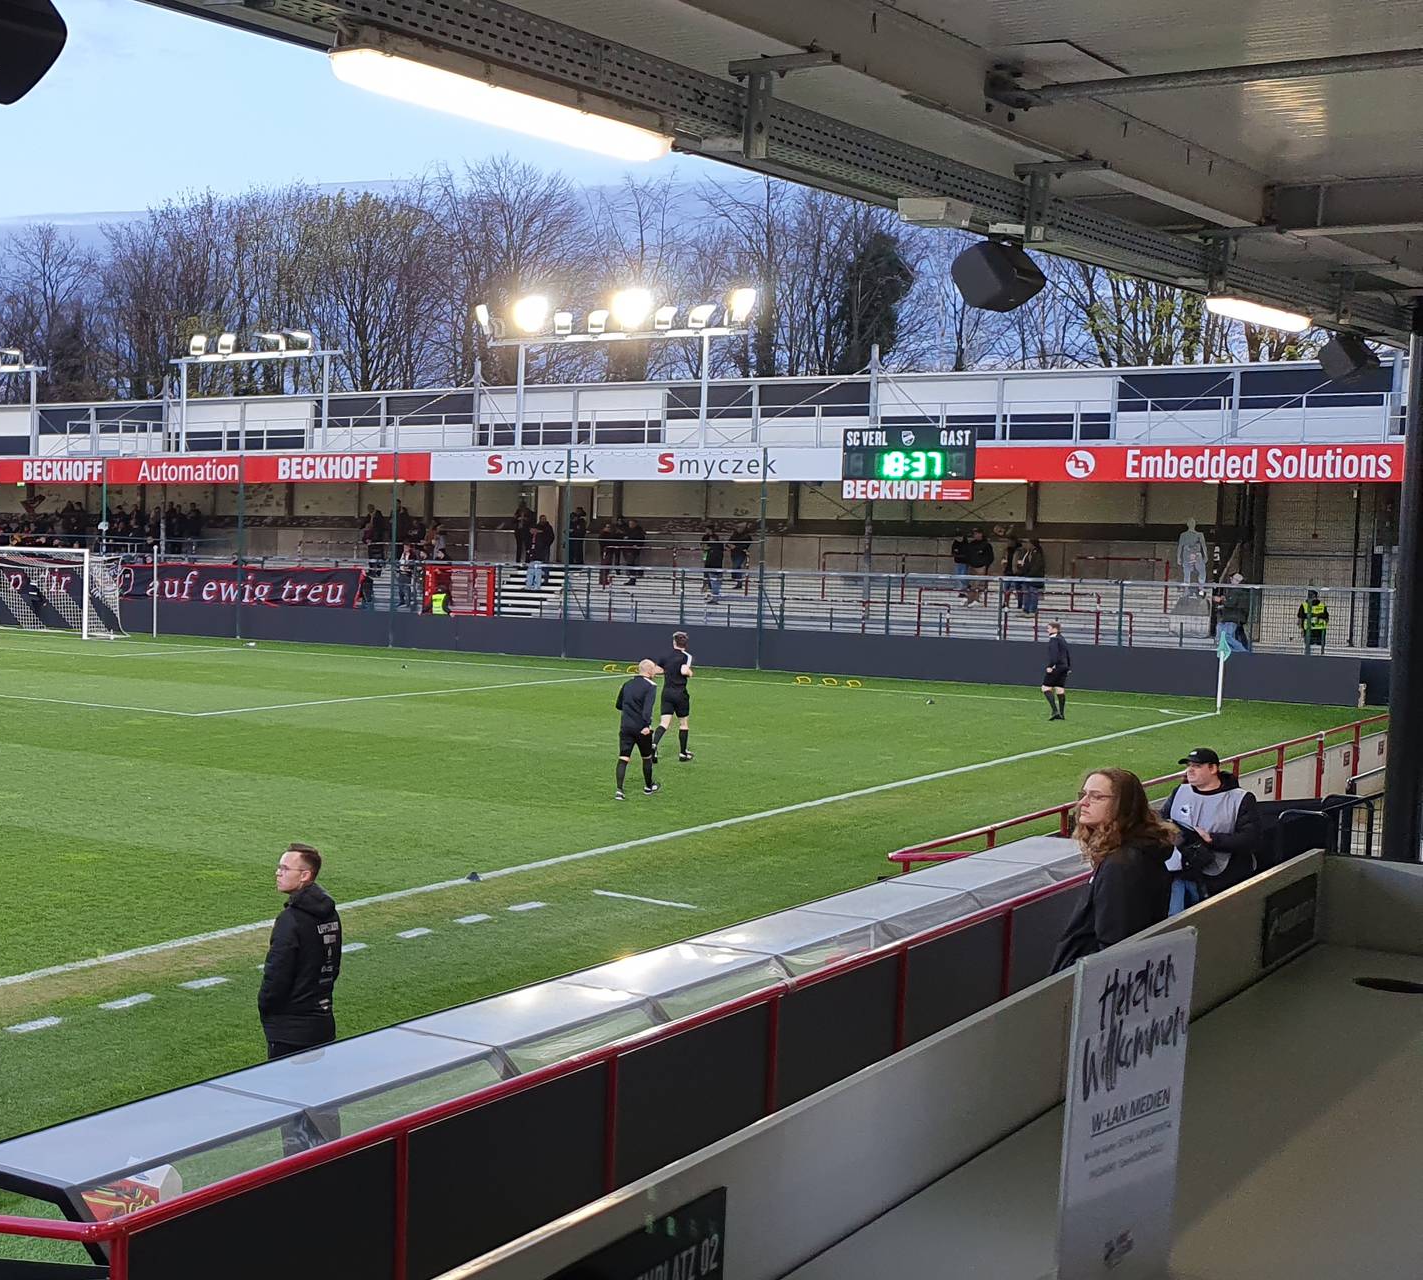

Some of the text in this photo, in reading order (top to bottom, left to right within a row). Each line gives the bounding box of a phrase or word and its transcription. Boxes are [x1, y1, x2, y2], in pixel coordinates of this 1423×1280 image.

[846, 430, 888, 447] SC VERL
[939, 430, 972, 447] GAST
[22, 460, 103, 482] BECKHOFF
[137, 458, 239, 482] Automation
[277, 455, 378, 480] BECKHOFF
[486, 453, 595, 478] Smyczek
[657, 452, 778, 478] Smyczek
[1124, 447, 1394, 480] Embedded Solutions
[842, 479, 943, 500] BECKHOFF
[145, 570, 199, 600] auf
[202, 573, 273, 604] ewig
[281, 577, 345, 604] treu
[1098, 953, 1177, 1031] Herzlich
[1091, 1086, 1171, 1133] W-LAN MEDIEN
[700, 1233, 719, 1276] 02
